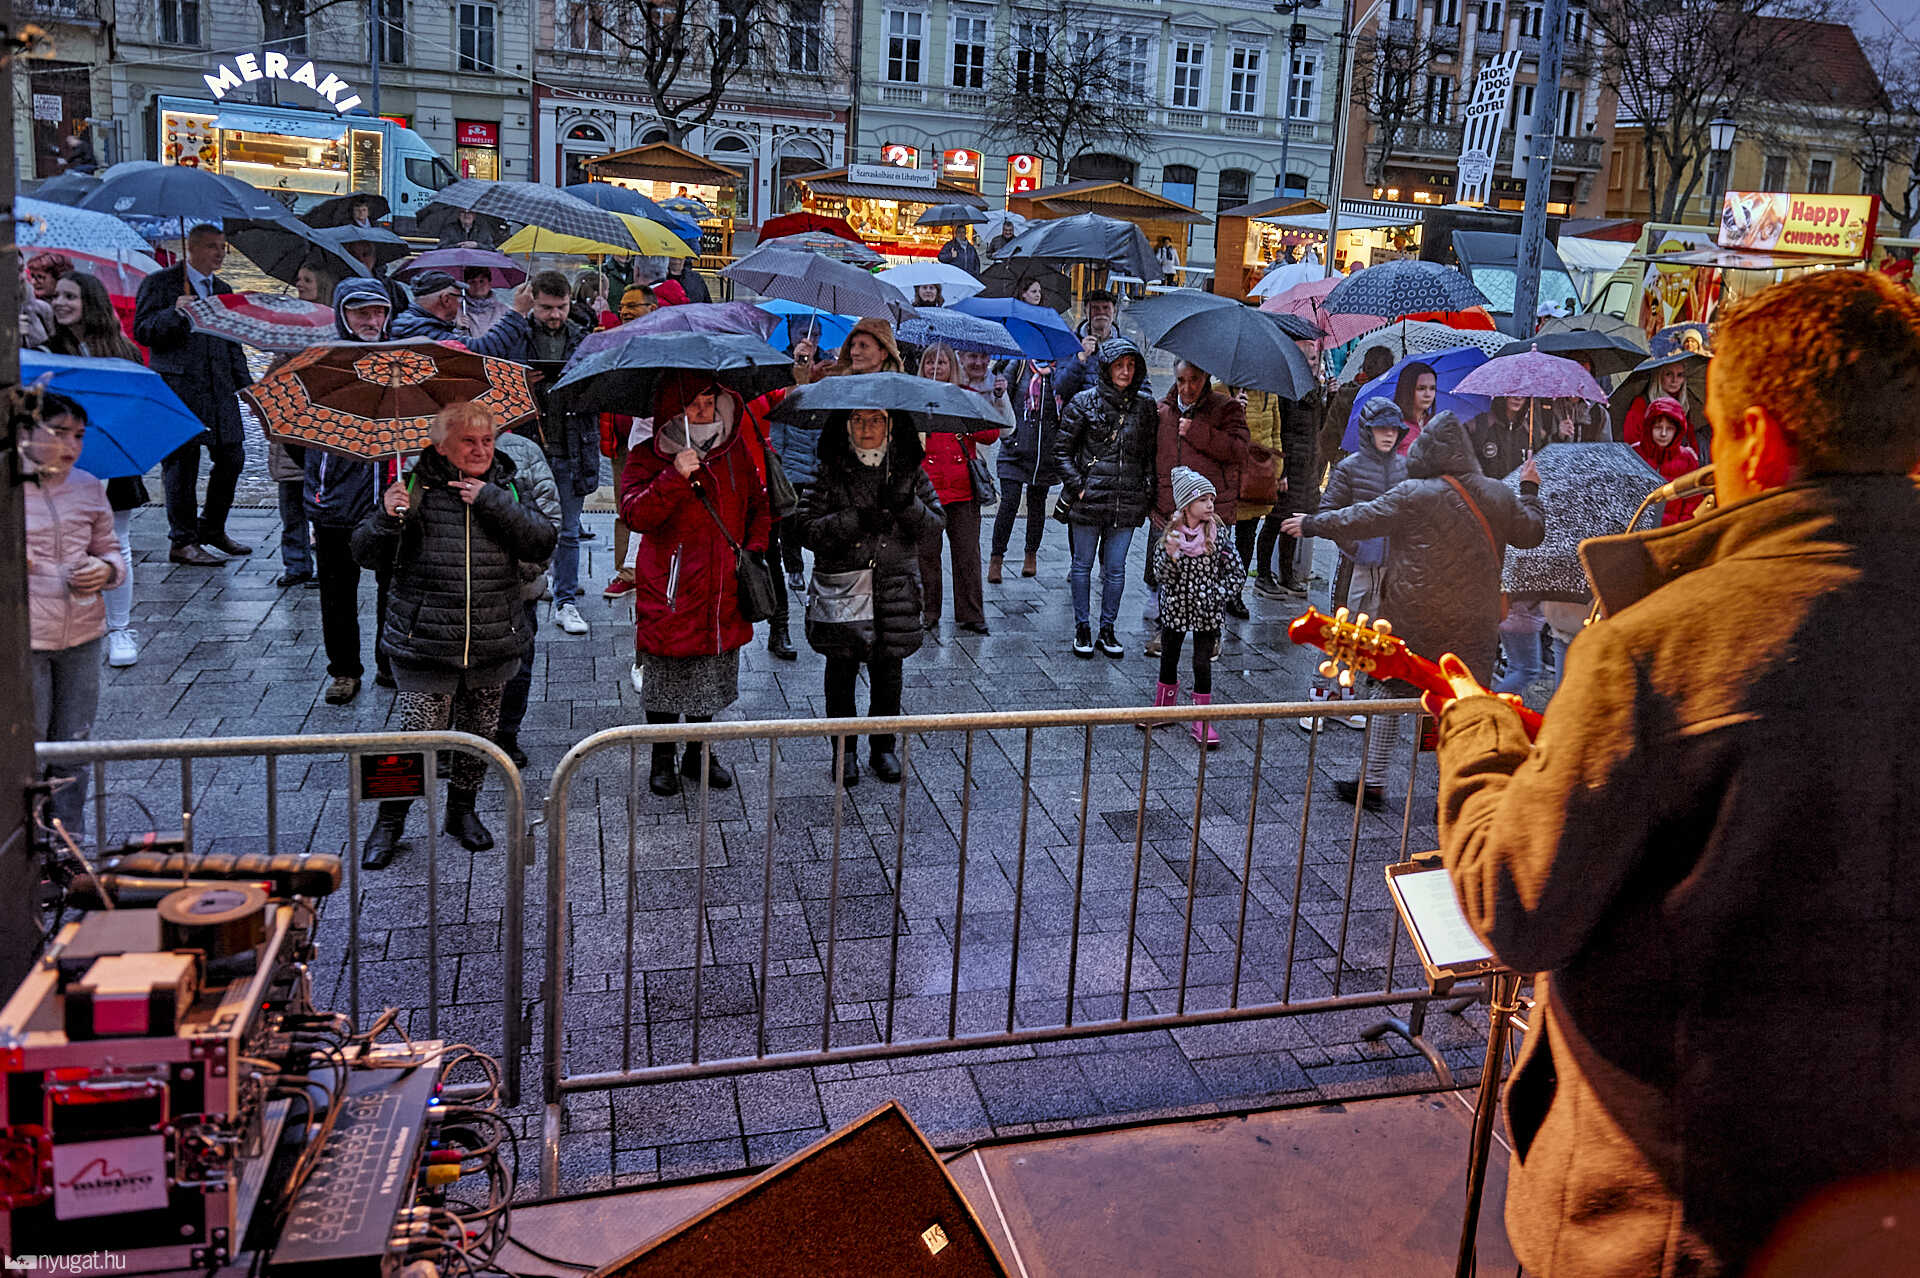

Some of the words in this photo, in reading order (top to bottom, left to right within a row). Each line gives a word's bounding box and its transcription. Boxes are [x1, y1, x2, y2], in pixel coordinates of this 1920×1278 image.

[203, 51, 362, 113] MERAKI
[1485, 77, 1510, 91] DOG
[1467, 99, 1505, 116] GOFRI
[1791, 200, 1850, 228] Happy
[1783, 230, 1840, 248] CHURROS
